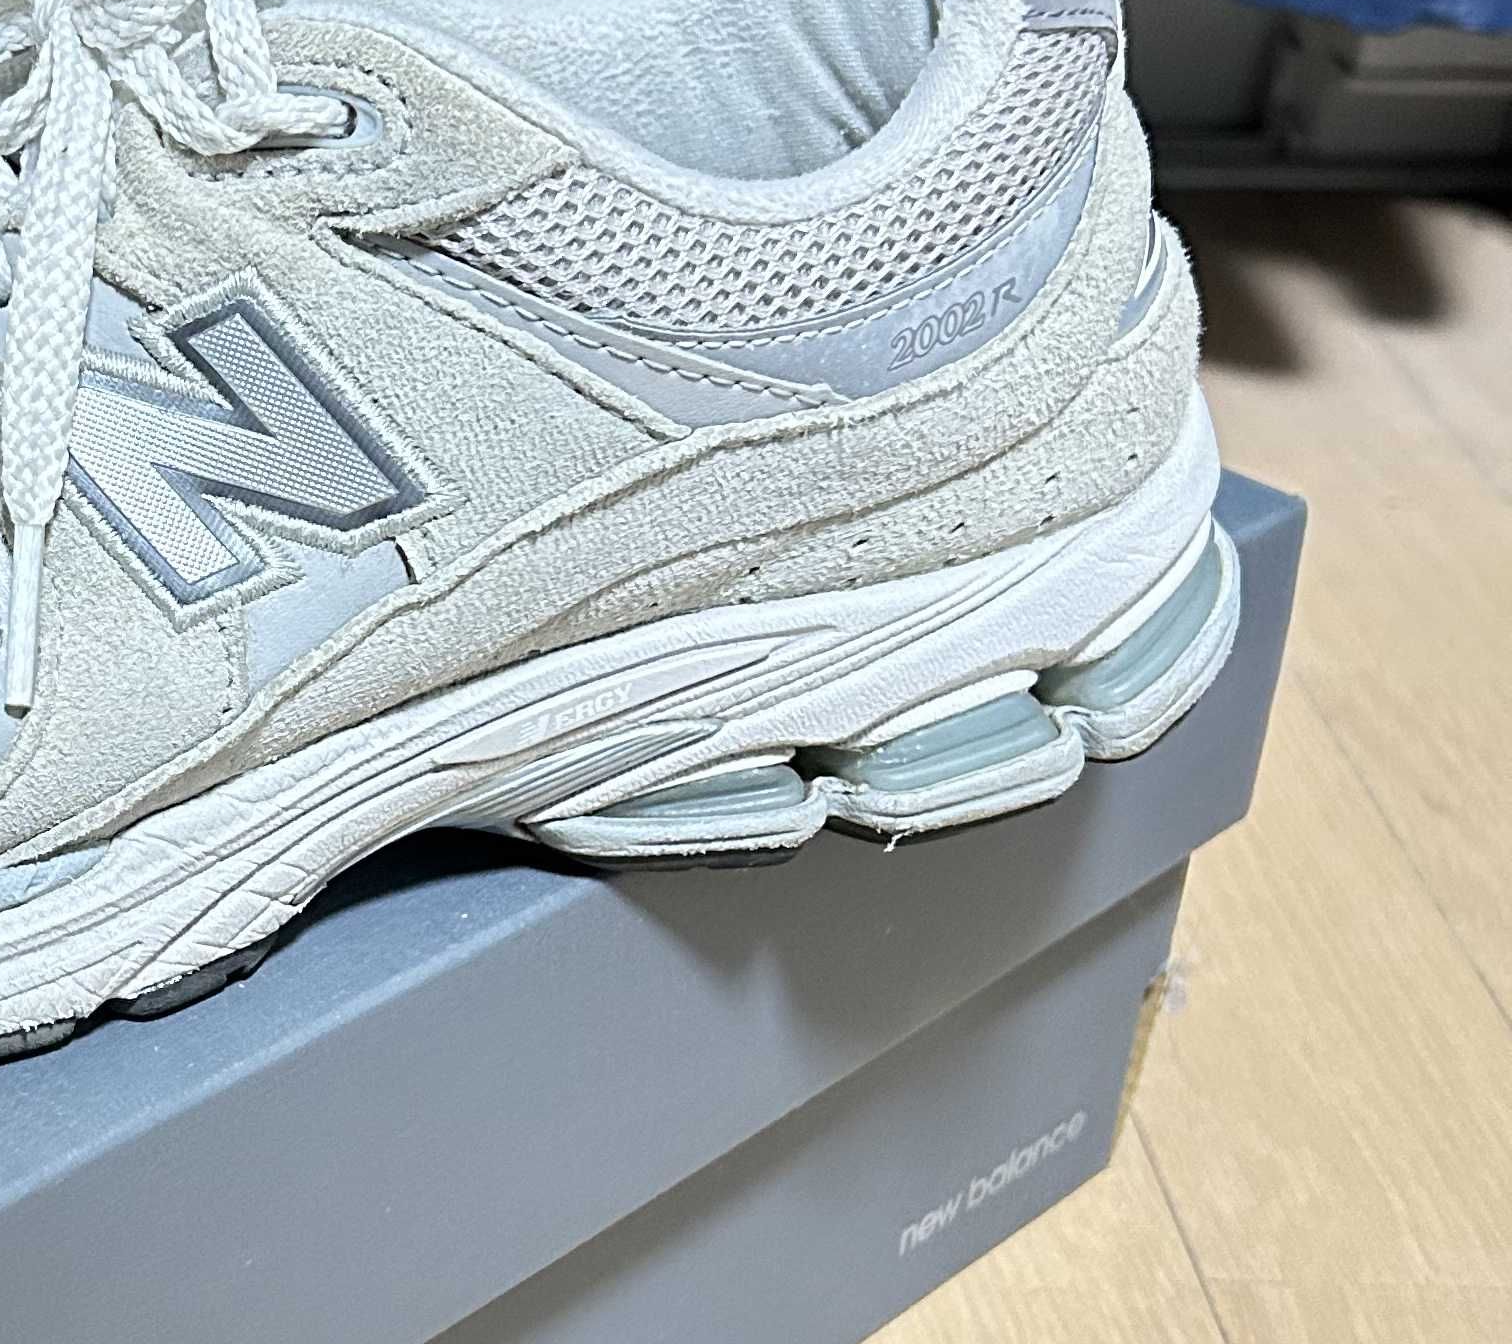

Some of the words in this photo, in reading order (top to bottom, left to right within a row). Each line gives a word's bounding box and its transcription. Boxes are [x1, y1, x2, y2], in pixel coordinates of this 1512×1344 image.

[65, 296, 426, 606] N
[898, 1190, 963, 1257] new
[966, 1109, 1086, 1209] balance
